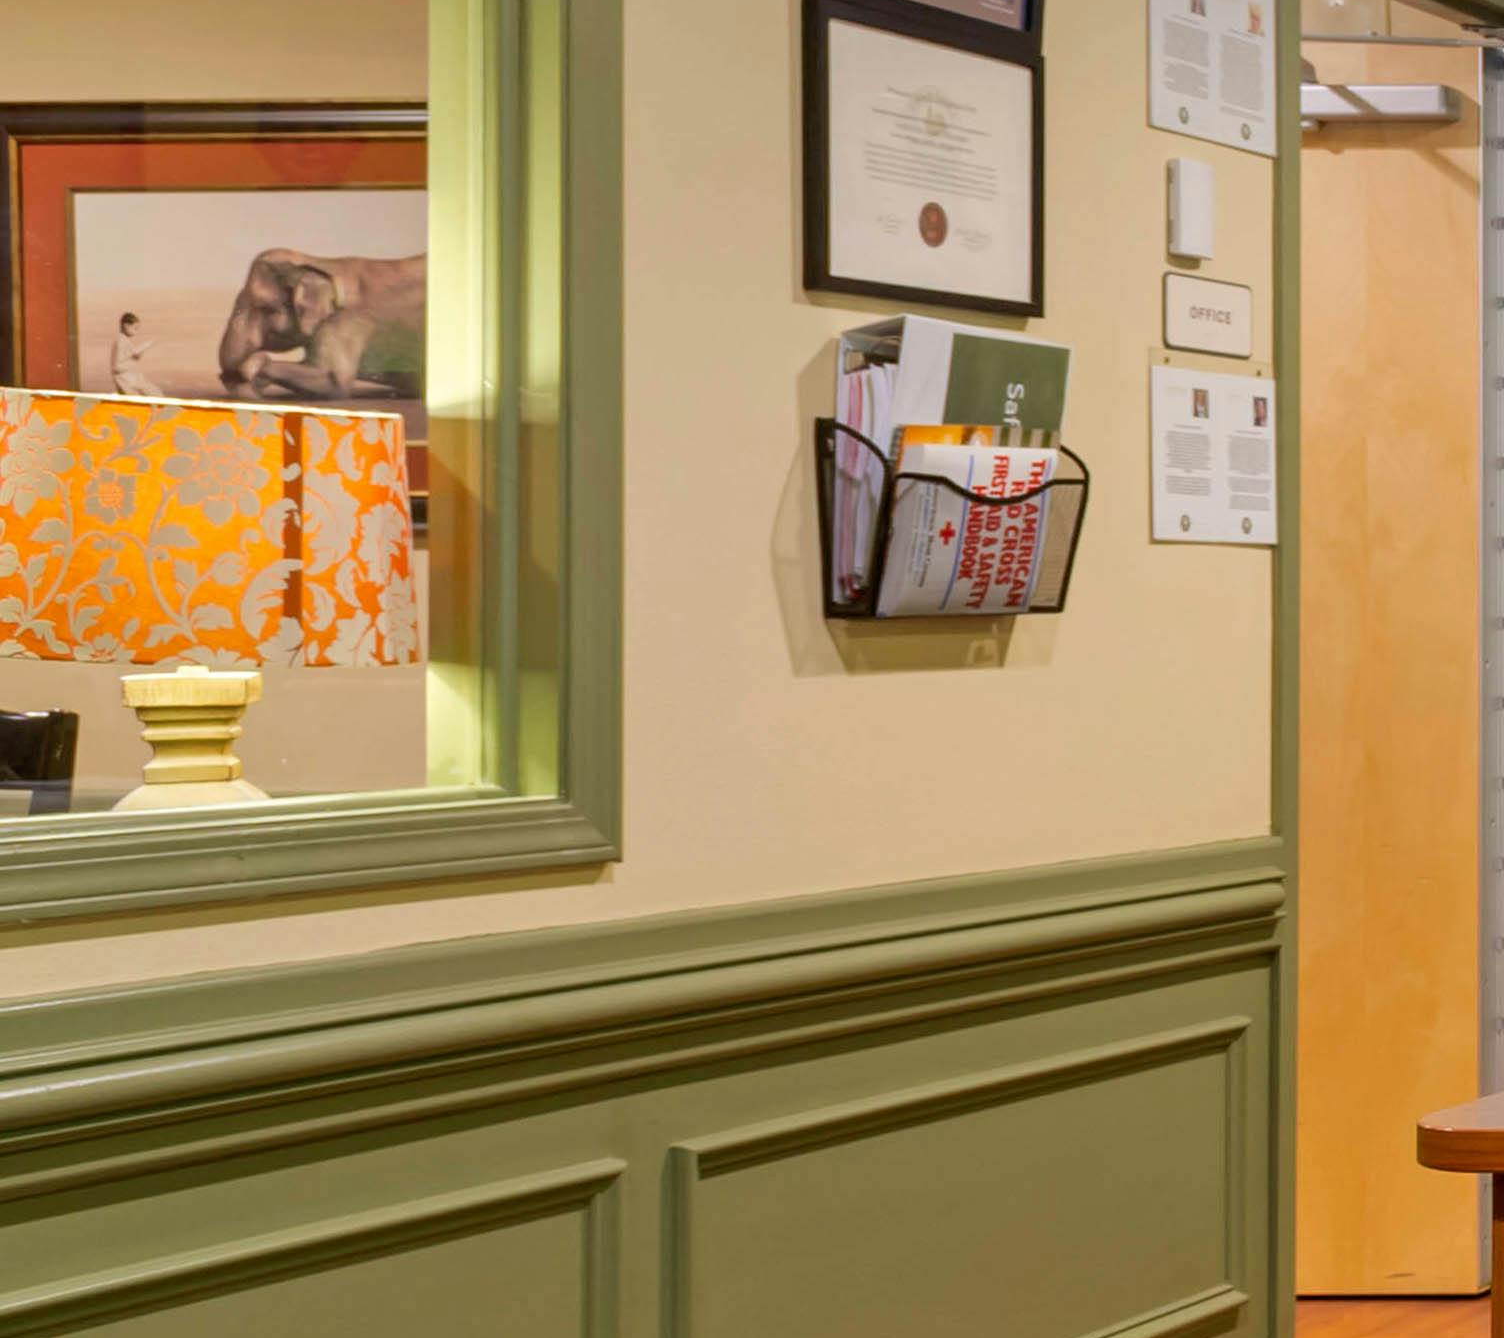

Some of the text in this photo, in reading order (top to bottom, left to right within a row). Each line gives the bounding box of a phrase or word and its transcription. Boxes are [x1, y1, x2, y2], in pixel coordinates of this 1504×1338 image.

[1189, 306, 1232, 325] OFFICE
[990, 455, 1009, 498] FIRST
[982, 536, 998, 548] &
[994, 481, 1026, 585] RD CROSS
[1003, 502, 1039, 608] AMERICAN
[964, 552, 995, 608] SAFETY
